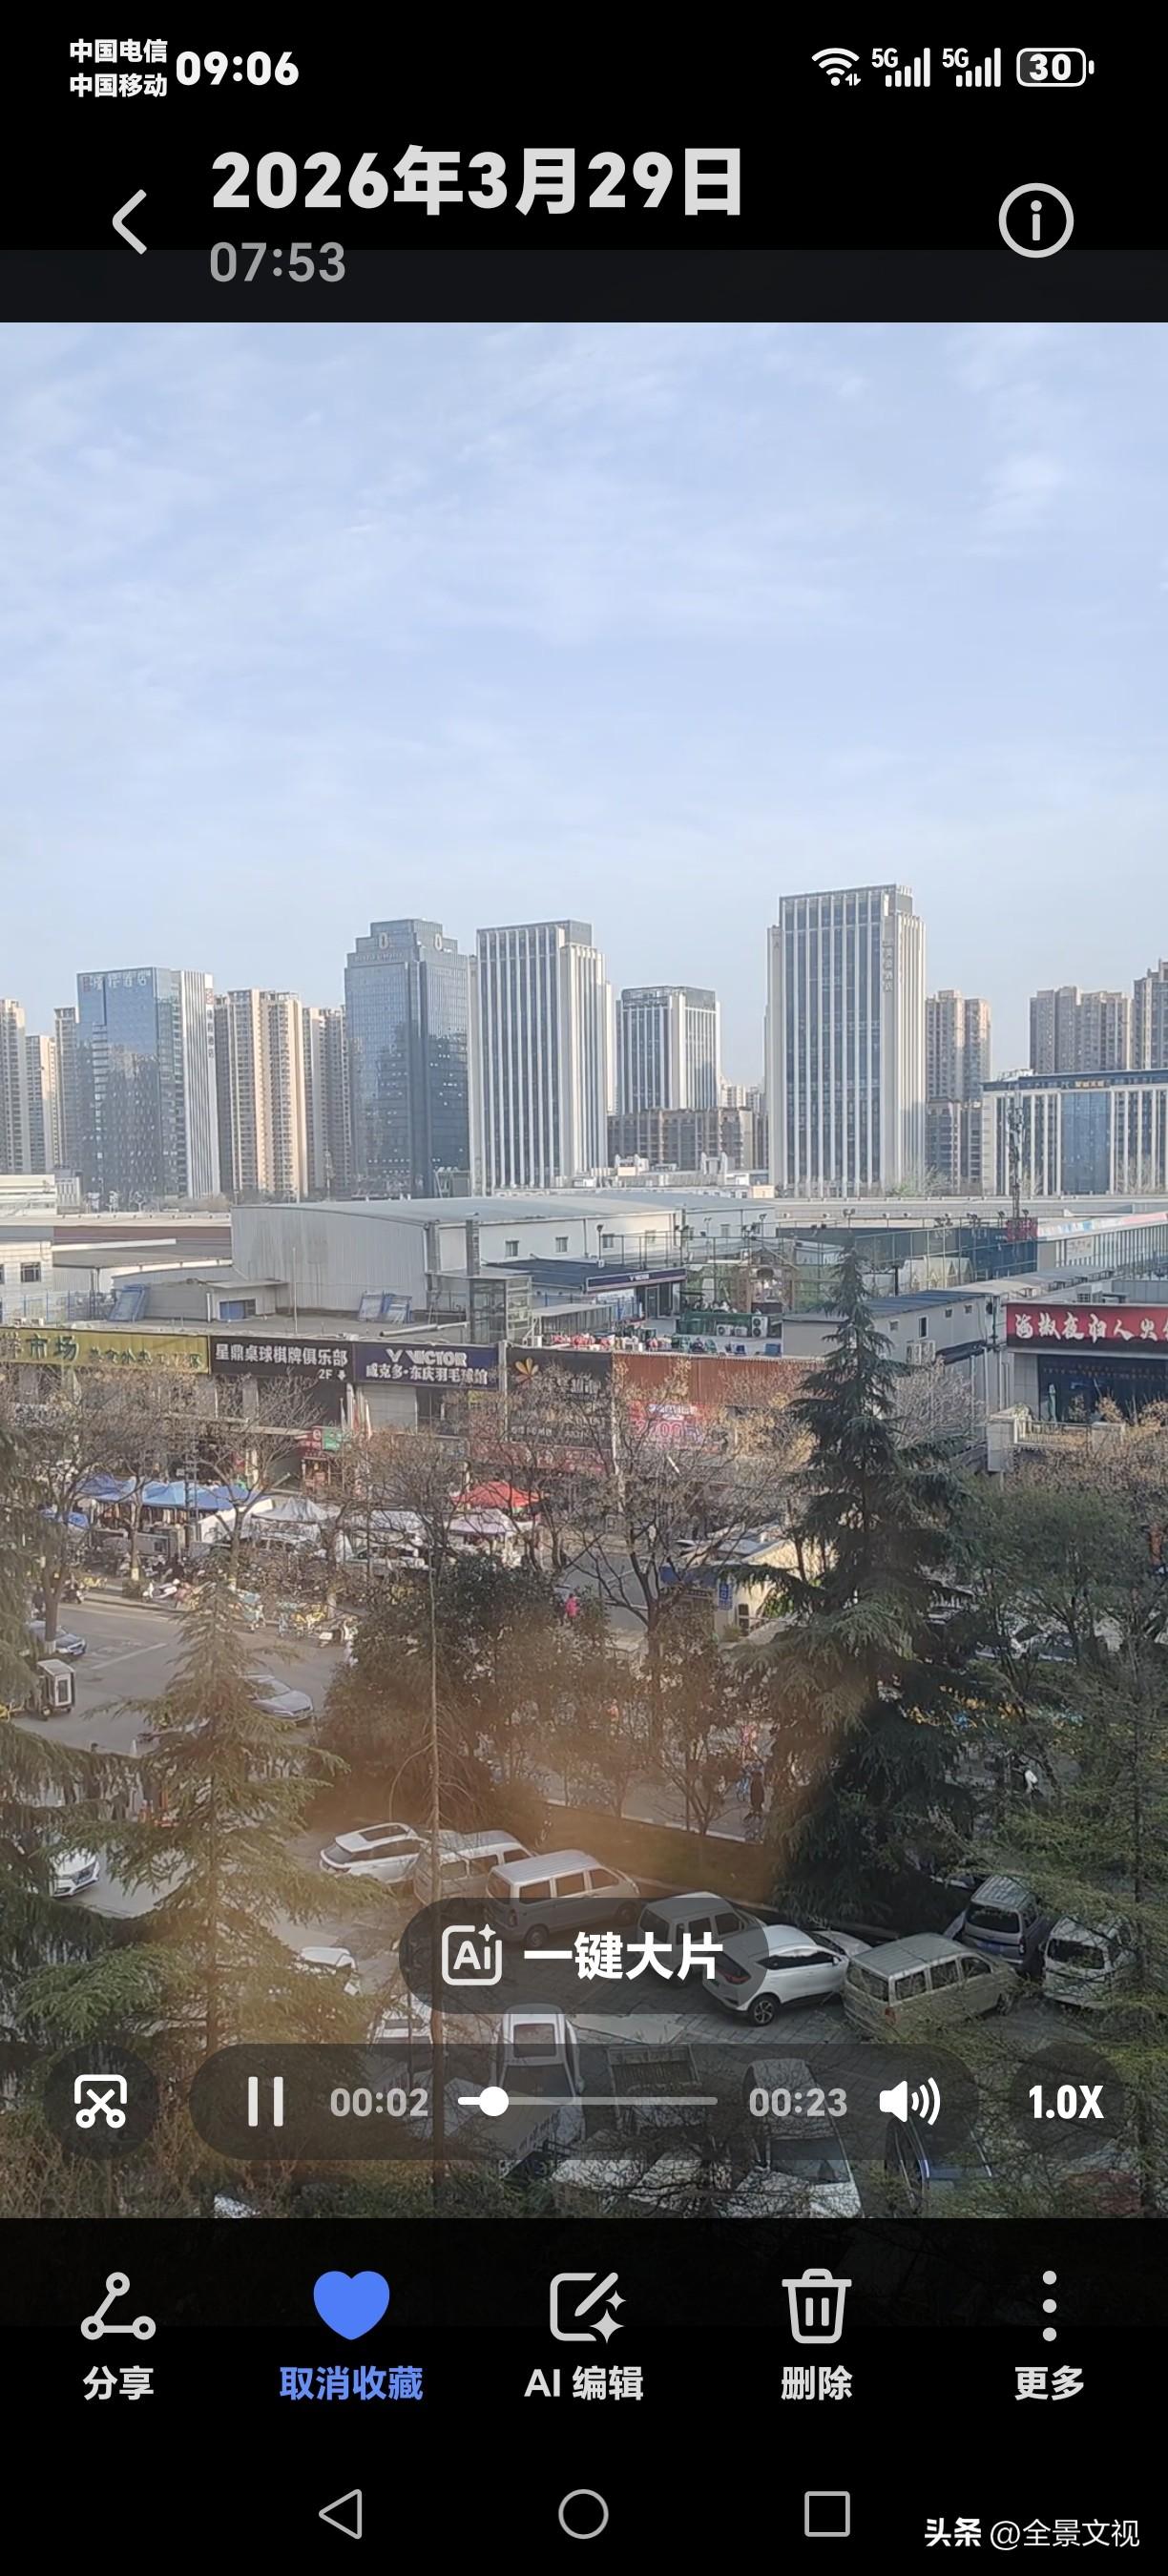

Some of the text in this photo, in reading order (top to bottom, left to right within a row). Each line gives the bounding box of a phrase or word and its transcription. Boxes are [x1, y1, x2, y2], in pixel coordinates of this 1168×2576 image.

[216, 1343, 348, 1367] 星鼎桌球棋牌俱乐部
[406, 1349, 468, 1367] VICTOR
[318, 1369, 333, 1381] 2F
